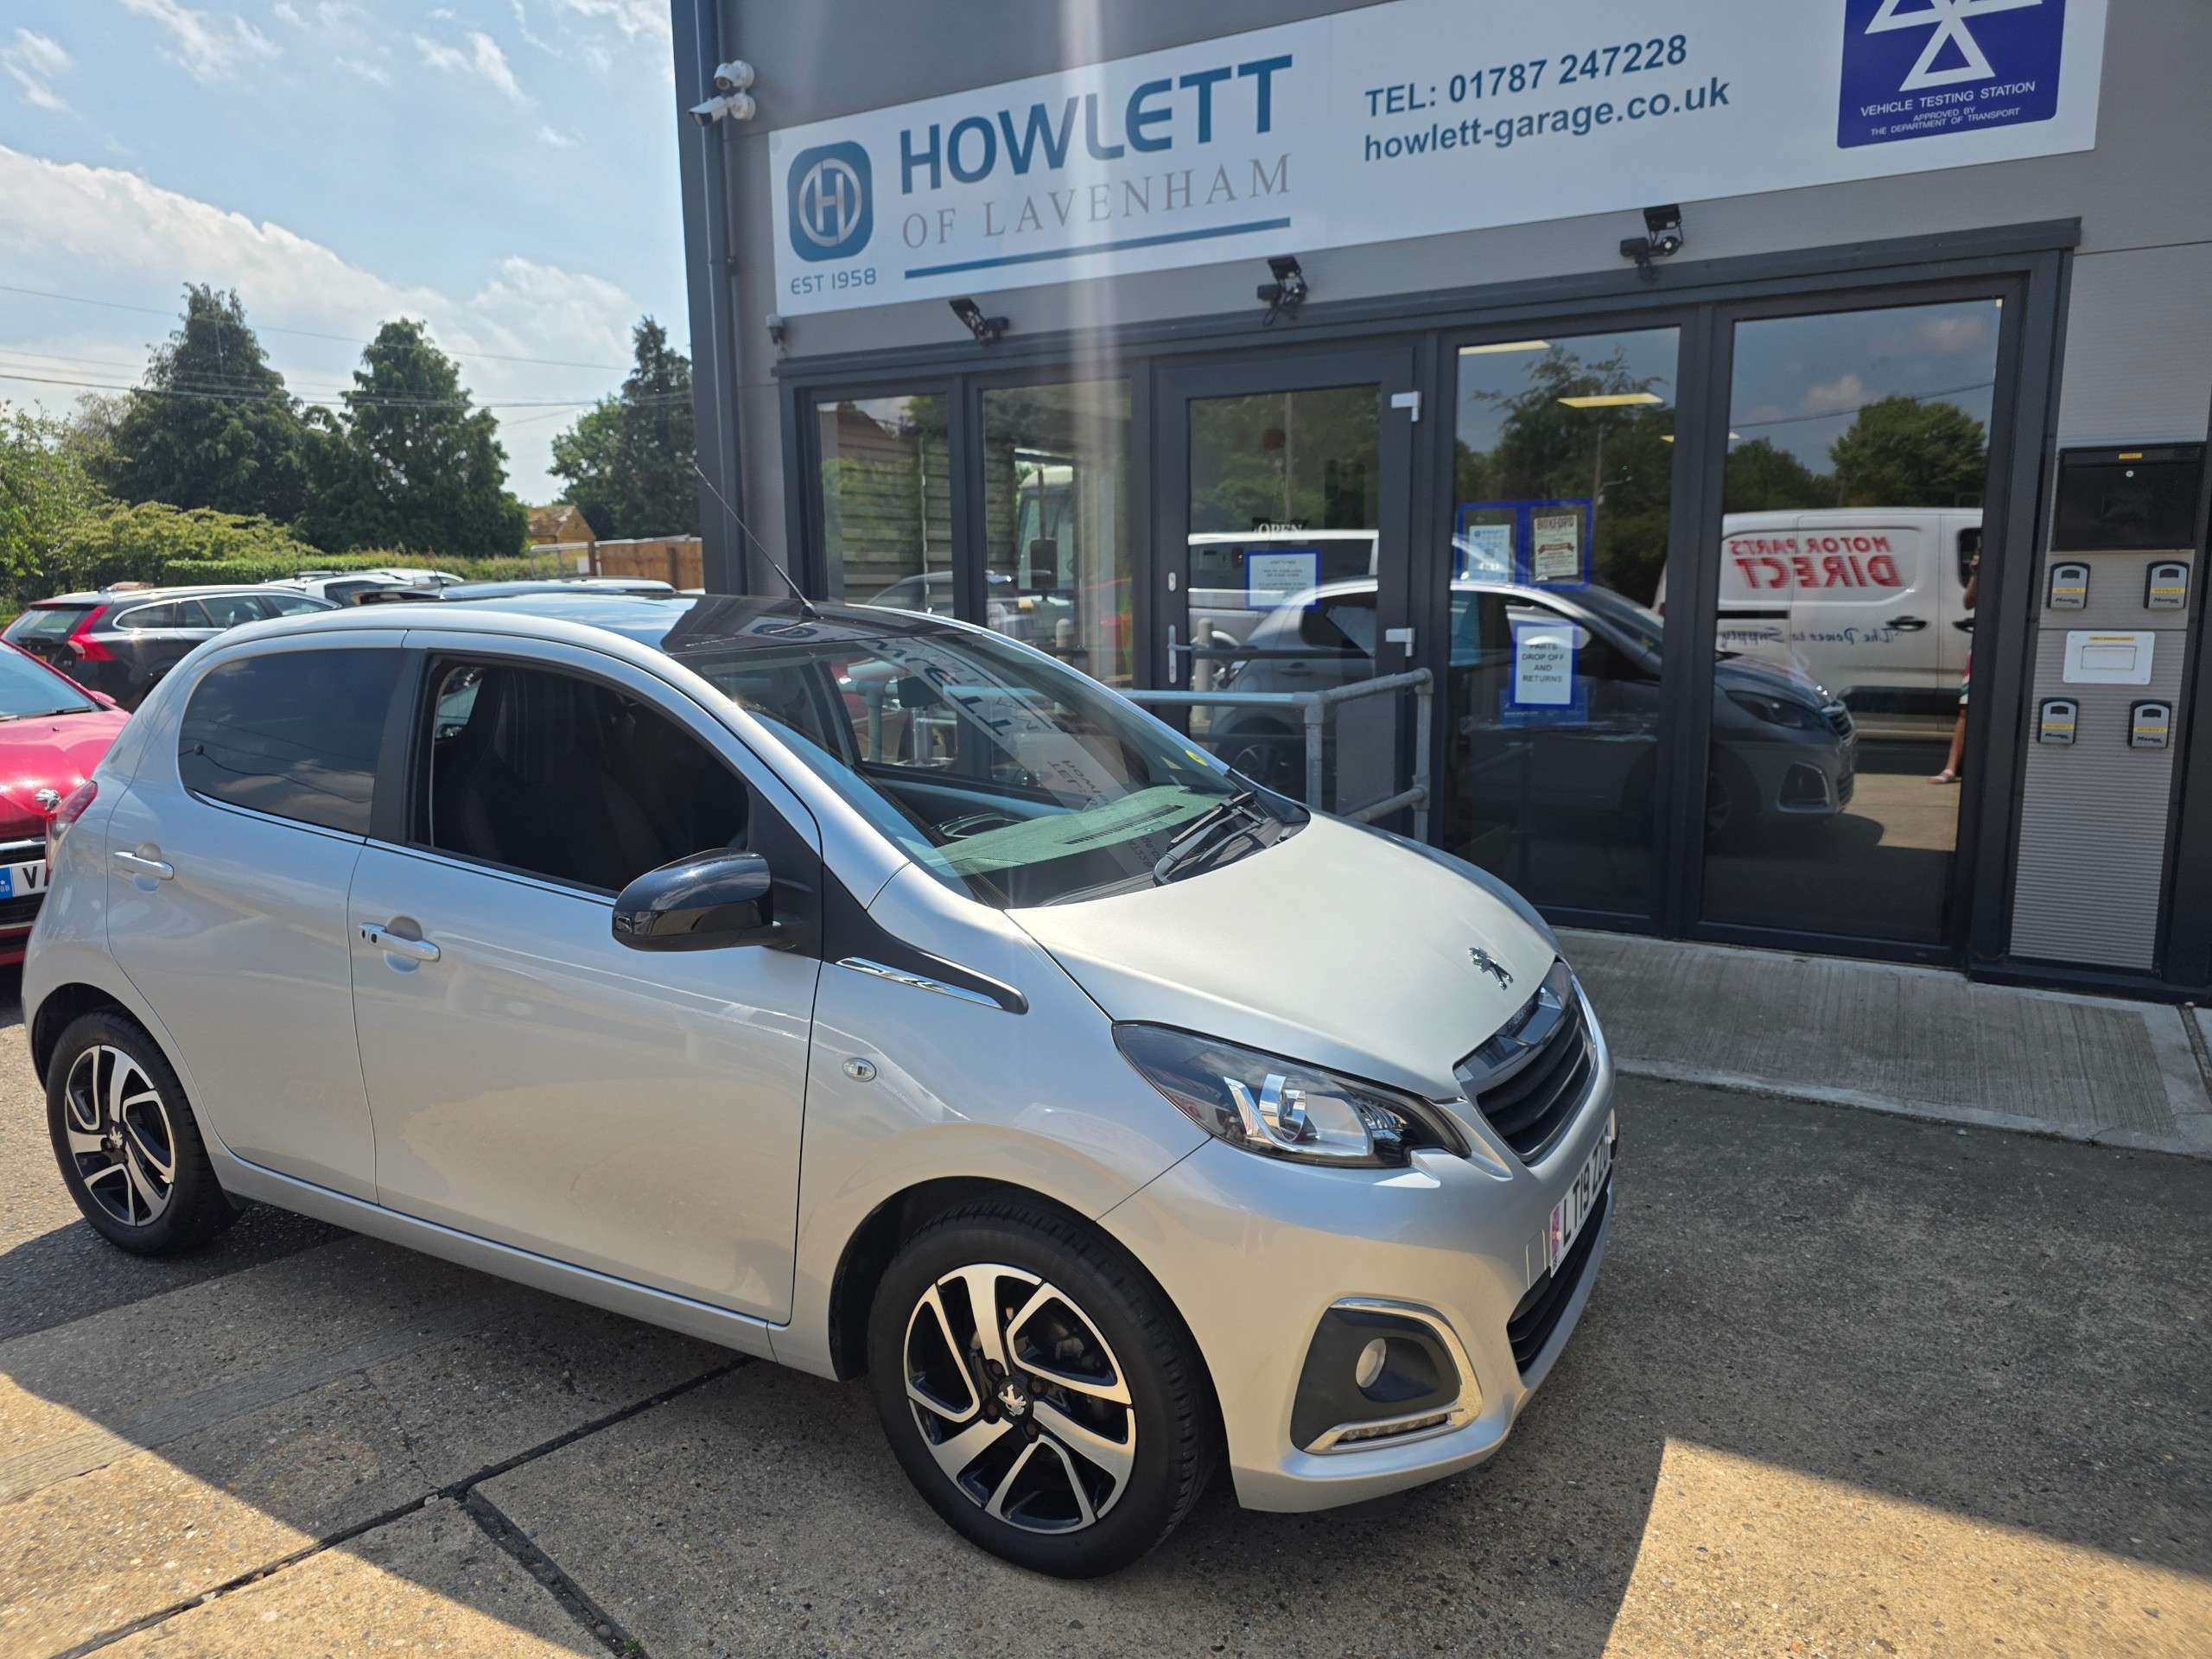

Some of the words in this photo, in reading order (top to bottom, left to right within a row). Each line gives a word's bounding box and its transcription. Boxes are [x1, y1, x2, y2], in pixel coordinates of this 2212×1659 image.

[1365, 83, 1436, 118] TEL:
[1449, 59, 1548, 104] 01787
[1558, 34, 1688, 86] 247228
[1860, 99, 1914, 117] VEHICLE
[1919, 90, 1974, 109] TESTING
[1980, 81, 2036, 99] STATION
[1912, 108, 1960, 123] APPROVED
[1963, 106, 1976, 116] BY
[900, 54, 1293, 195] HOWLETT
[1364, 76, 1731, 162] howlett-garage.co.uk
[1871, 127, 1887, 136] THE
[1891, 118, 1947, 134] DEPARTMENT
[1950, 116, 1964, 125] OF
[1967, 107, 2021, 123] TRANSPORT
[903, 207, 957, 249] OF
[983, 153, 1293, 238] LAVENHAM
[791, 274, 824, 295] EST
[831, 267, 877, 289] 1958
[1564, 1162, 1590, 1247] LT19
